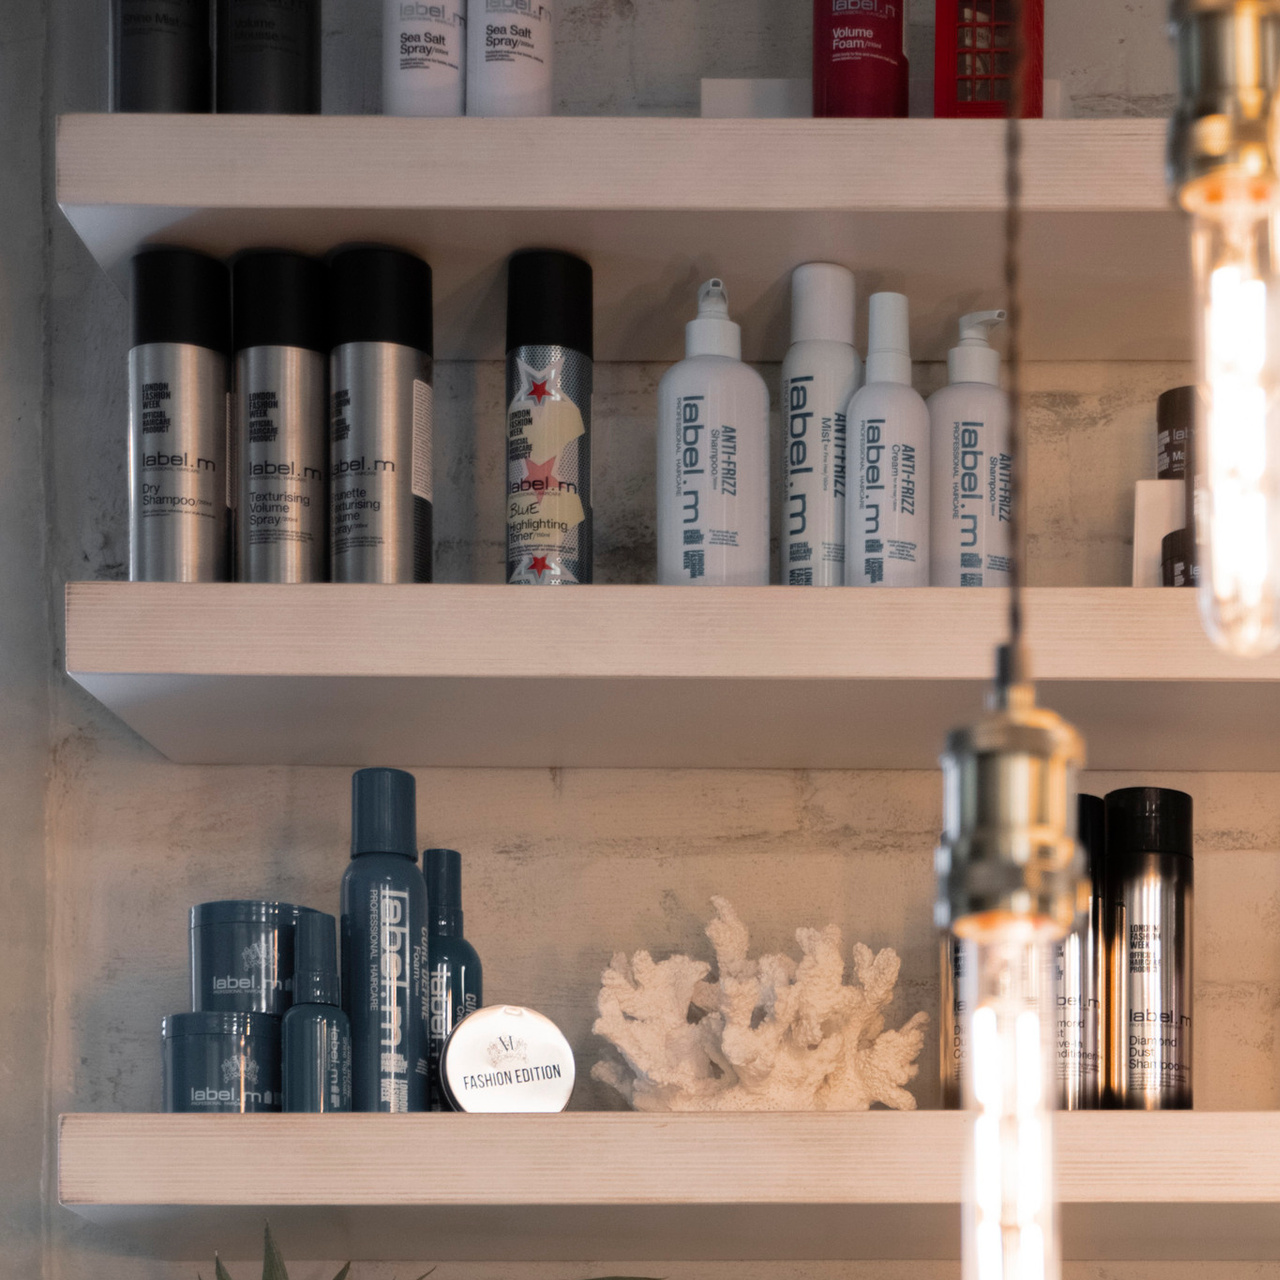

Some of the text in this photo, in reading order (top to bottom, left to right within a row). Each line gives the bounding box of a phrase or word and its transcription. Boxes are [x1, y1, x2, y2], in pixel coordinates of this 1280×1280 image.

[400, 32, 446, 46] Sea Salt
[486, 24, 532, 39] Sea Salt
[832, 27, 874, 39] Volume
[822, 418, 831, 442] Mist
[142, 452, 216, 472] label.m
[683, 396, 704, 523] label.m
[722, 425, 736, 496] ANTI-FRIZZ
[790, 376, 813, 535] label.m
[834, 412, 846, 498] ANTI-FRIZZ
[891, 444, 900, 477] Cream
[250, 460, 322, 480] label.m
[865, 419, 885, 534] label.m
[901, 444, 915, 515] ANTI-FRIZZ
[142, 483, 160, 495] Dry
[509, 476, 577, 494] label.m
[960, 421, 984, 547] label.m
[998, 453, 1012, 522] ANTI-FRIZZ
[250, 492, 310, 507] Texturising
[250, 503, 290, 513] Volume
[509, 502, 540, 518] BLUE
[509, 519, 568, 533] Highlighting
[369, 889, 378, 1011] PROFESSIONAL HAIRCARE
[381, 889, 409, 1046] label.m
[213, 975, 283, 990] label.m
[1130, 1008, 1192, 1027] label.m
[1130, 1035, 1177, 1046] Diamond
[1130, 1046, 1155, 1057] Dust
[463, 1064, 562, 1090] FASHION EDITION
